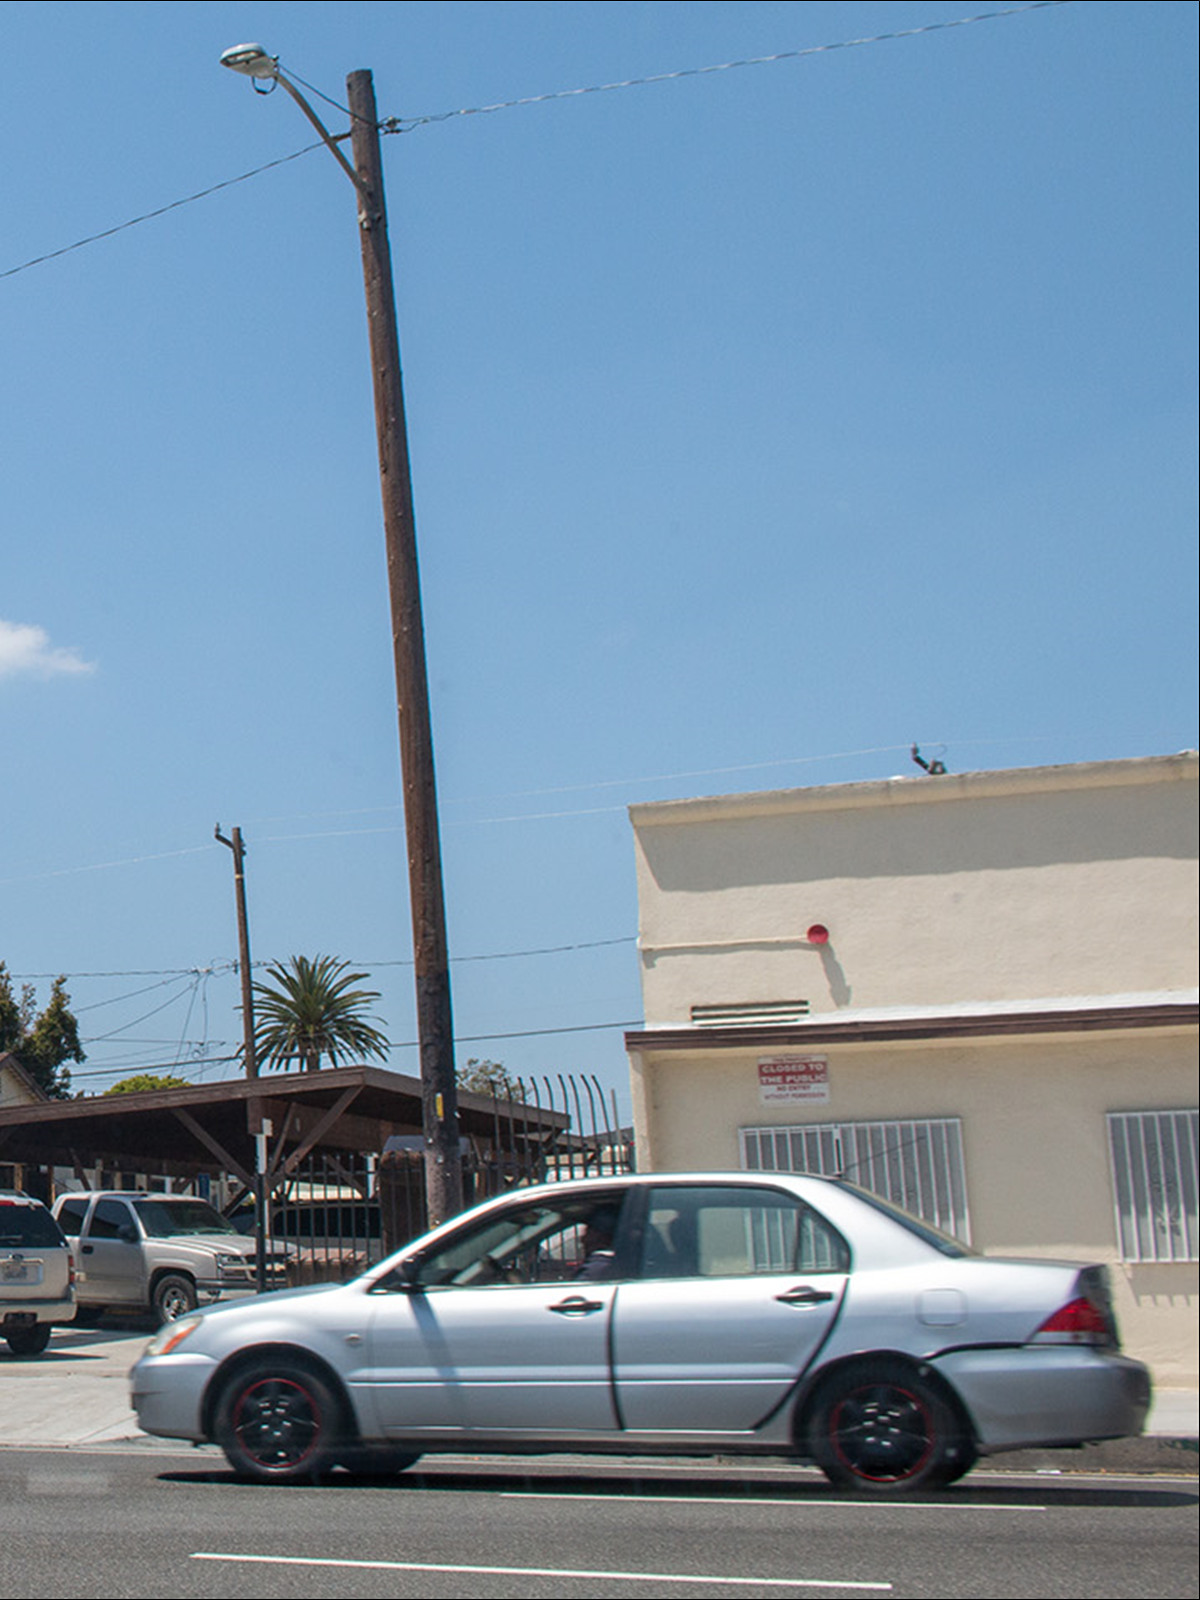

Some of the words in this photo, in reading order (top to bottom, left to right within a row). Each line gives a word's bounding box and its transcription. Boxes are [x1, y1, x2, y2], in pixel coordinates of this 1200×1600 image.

[762, 1064, 806, 1074] CLOSED
[808, 1063, 824, 1071] TO
[761, 1076, 783, 1084] THE
[785, 1073, 827, 1083] PUBLIC
